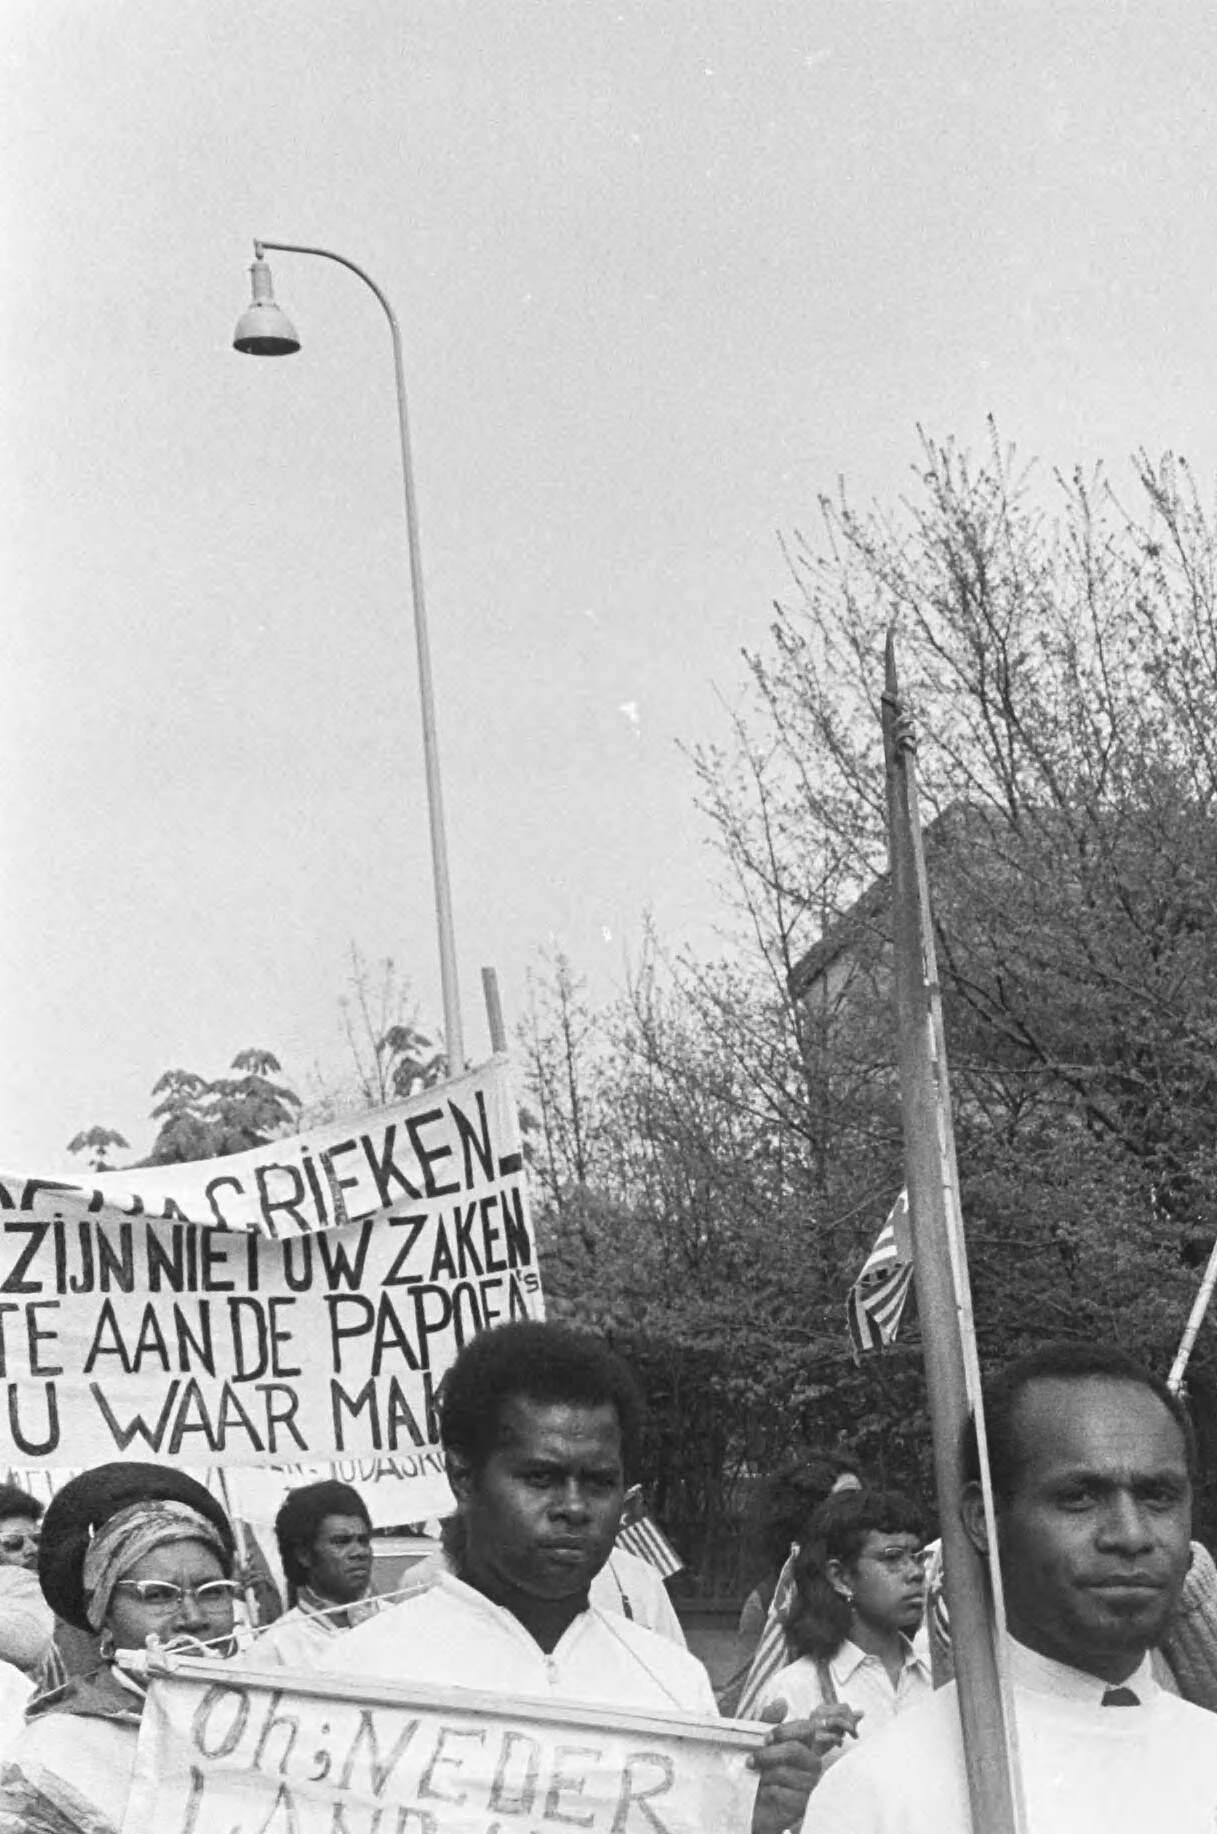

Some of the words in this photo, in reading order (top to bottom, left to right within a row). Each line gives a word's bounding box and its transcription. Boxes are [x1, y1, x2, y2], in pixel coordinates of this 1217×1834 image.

[281, 1219, 374, 1293] UW
[381, 1186, 532, 1287] ZAKEN
[83, 1297, 216, 1378] AAN
[227, 1296, 302, 1384] DE
[7, 1380, 60, 1457] U
[89, 1377, 309, 1454] WAAR
